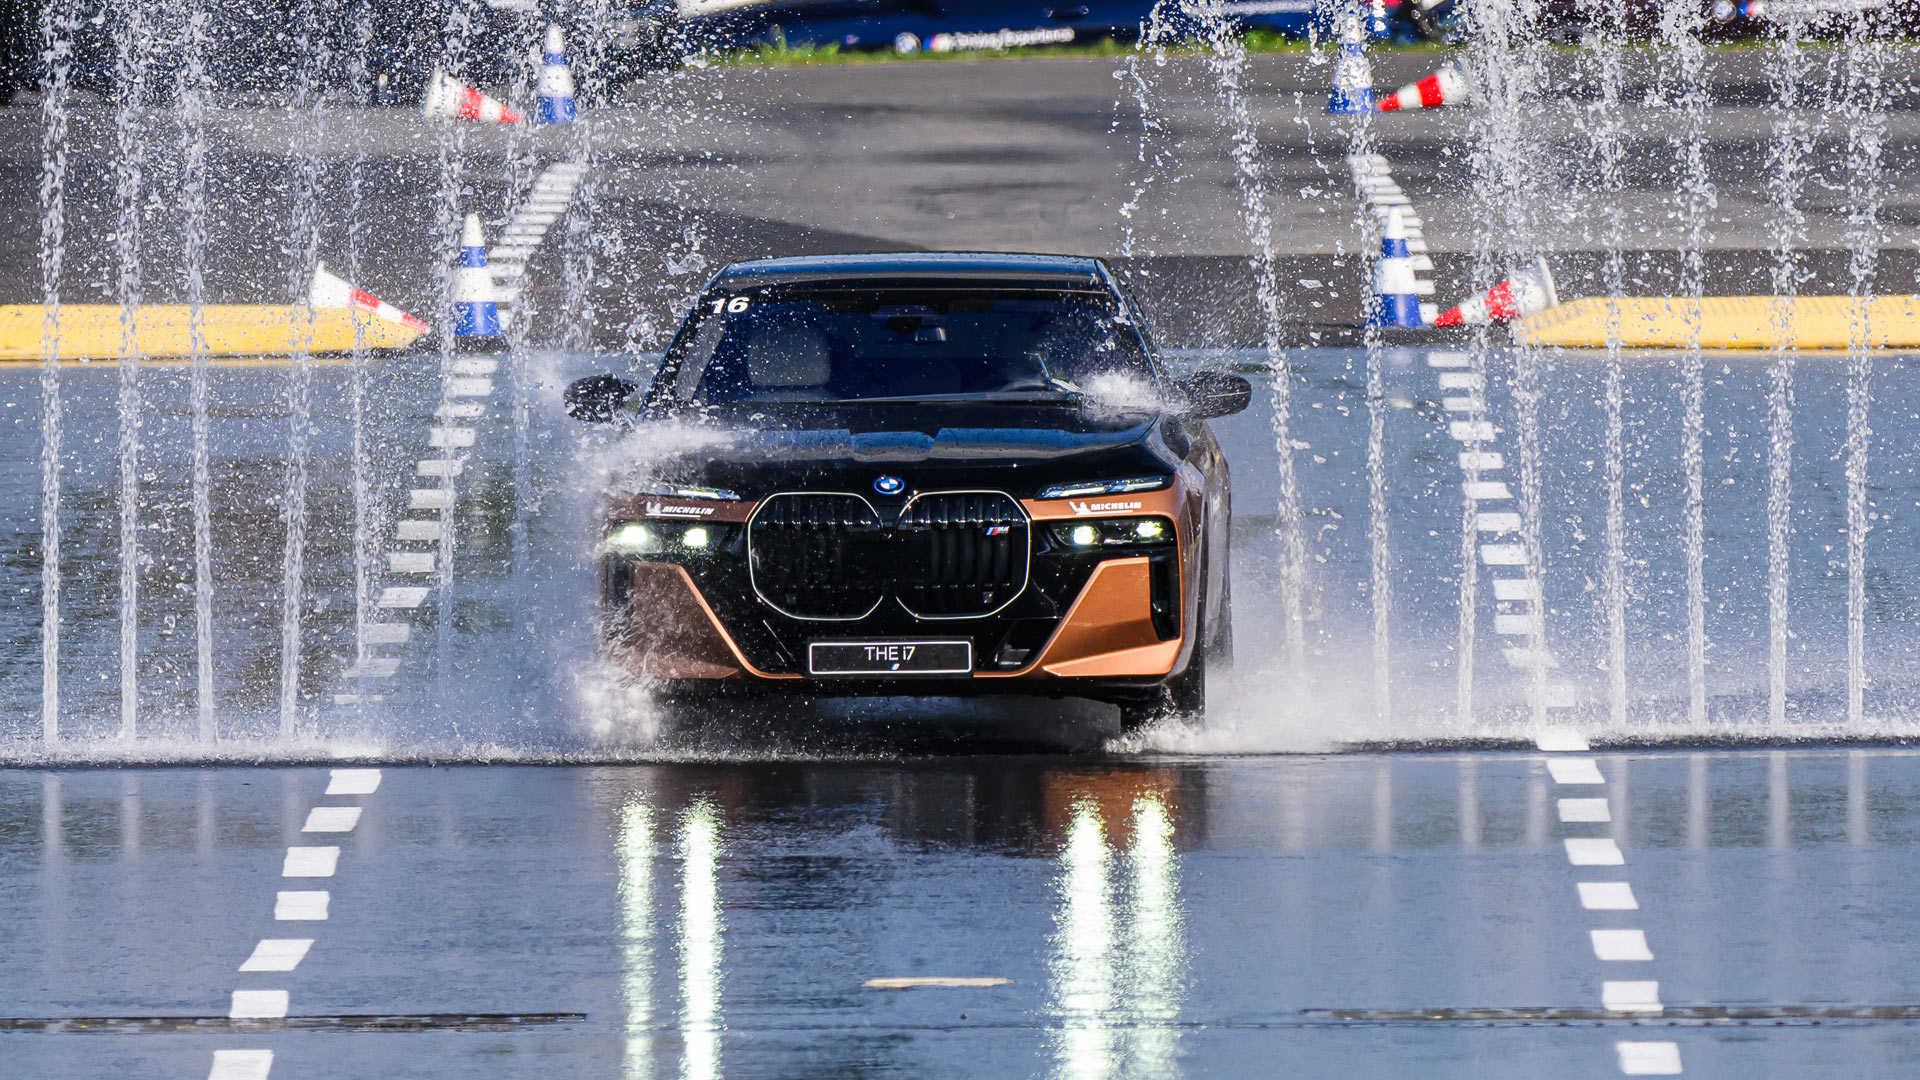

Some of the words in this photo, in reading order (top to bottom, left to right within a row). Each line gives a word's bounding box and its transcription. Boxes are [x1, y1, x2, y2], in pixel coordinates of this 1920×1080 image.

[711, 296, 750, 314] 16
[662, 505, 715, 515] MICHELIN
[1090, 501, 1142, 511] MICHELIN
[864, 646, 899, 661] THE
[902, 645, 916, 661] i7
